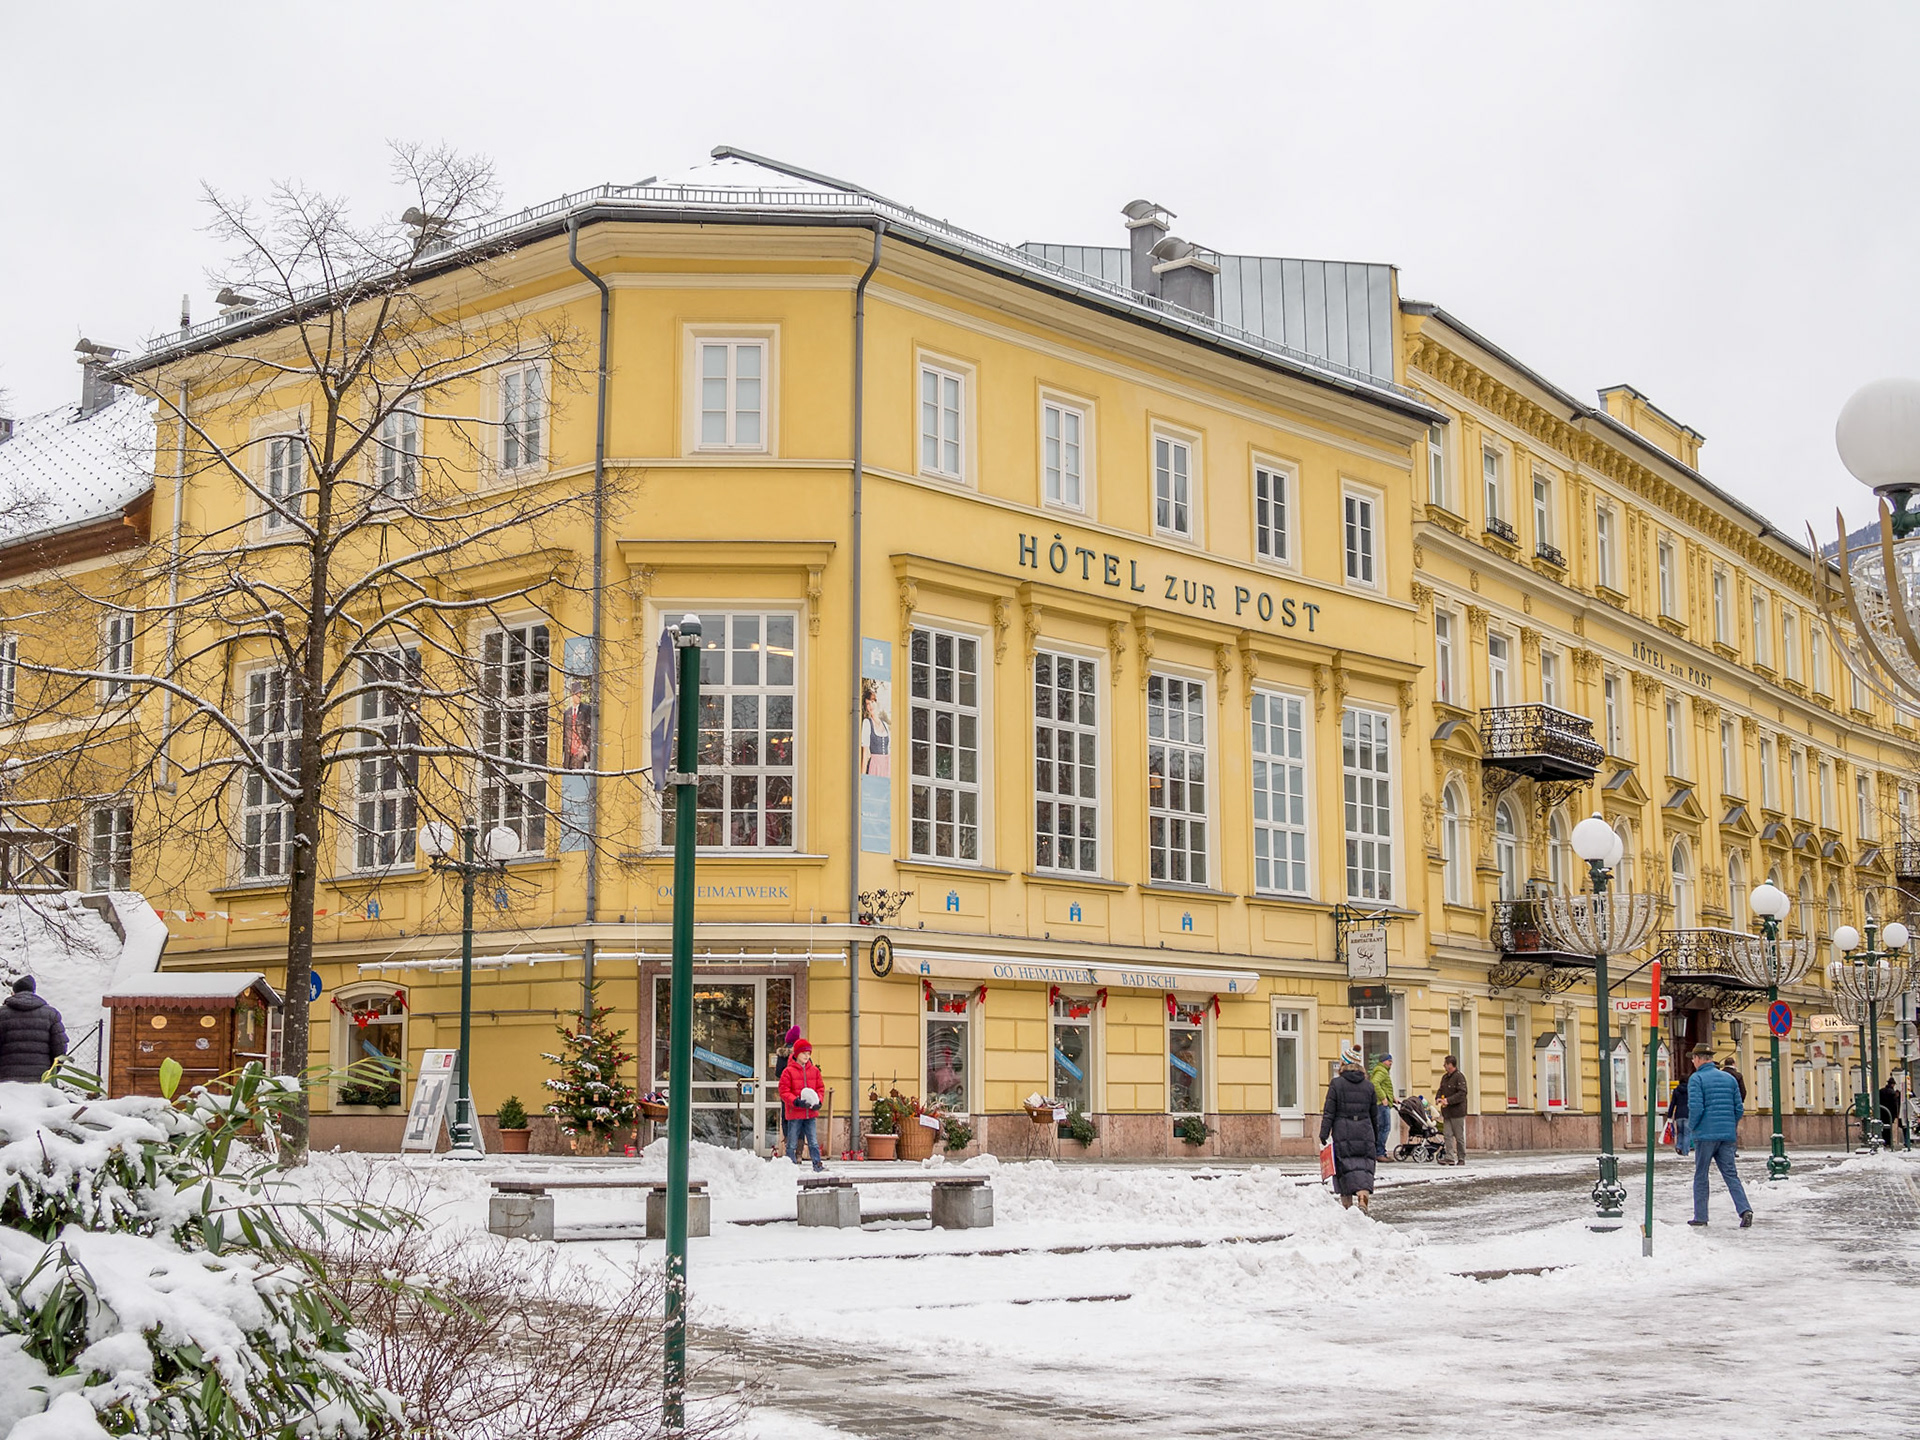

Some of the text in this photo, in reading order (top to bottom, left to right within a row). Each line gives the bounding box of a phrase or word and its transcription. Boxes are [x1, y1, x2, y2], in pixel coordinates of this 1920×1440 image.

[1019, 533, 1320, 631] HÔTEL ZUR POST
[1670, 663, 1683, 678] ZUR
[1688, 667, 1712, 690] POST
[697, 886, 789, 898] EIMATWERK
[1019, 967, 1098, 984] HEIMATWERK
[1121, 973, 1144, 986] BAD
[1147, 975, 1179, 988] ISCHL
[1824, 1017, 1838, 1026] tik
